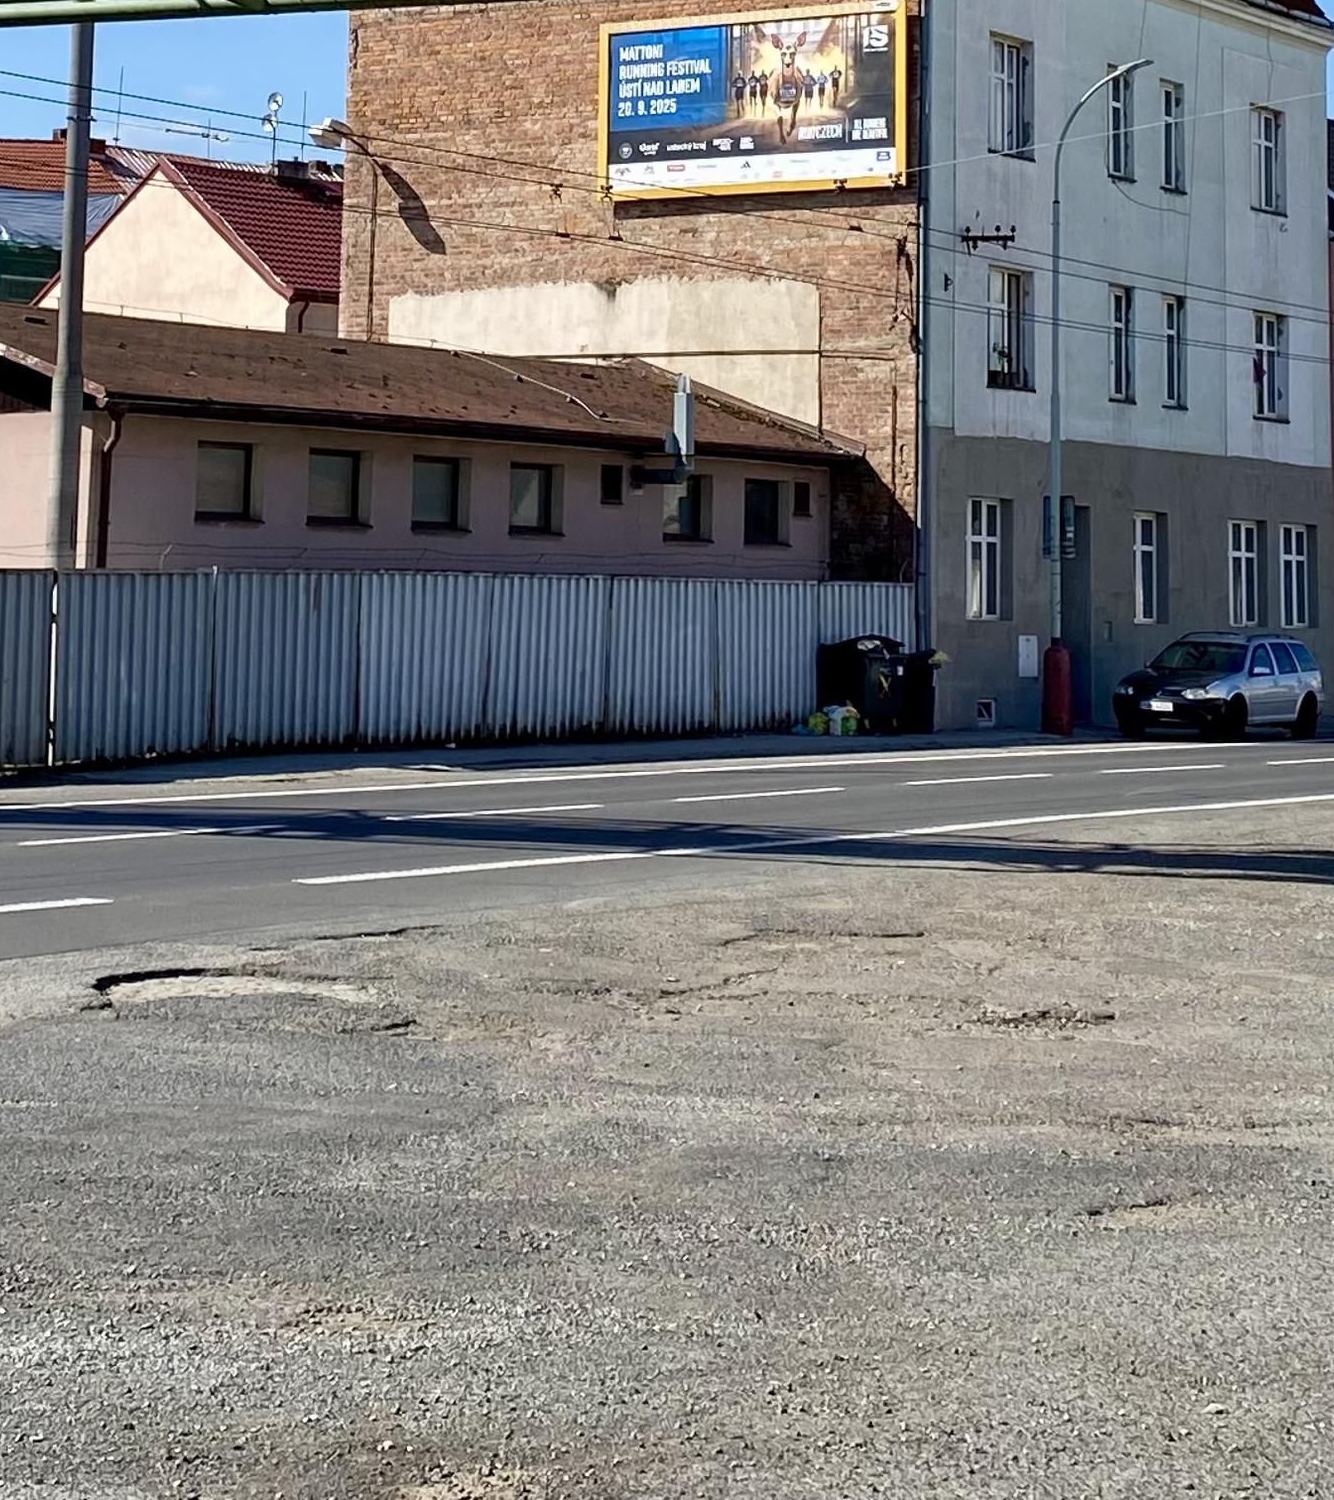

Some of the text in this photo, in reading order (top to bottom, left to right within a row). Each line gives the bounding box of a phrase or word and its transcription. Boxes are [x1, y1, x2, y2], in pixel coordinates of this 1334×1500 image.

[619, 43, 664, 62] MATTONI
[619, 58, 712, 80] RUNNING FESTIVAL
[619, 77, 701, 99] ÚSTÍ NAD LABEM
[618, 98, 677, 117] 20. 9. 2025
